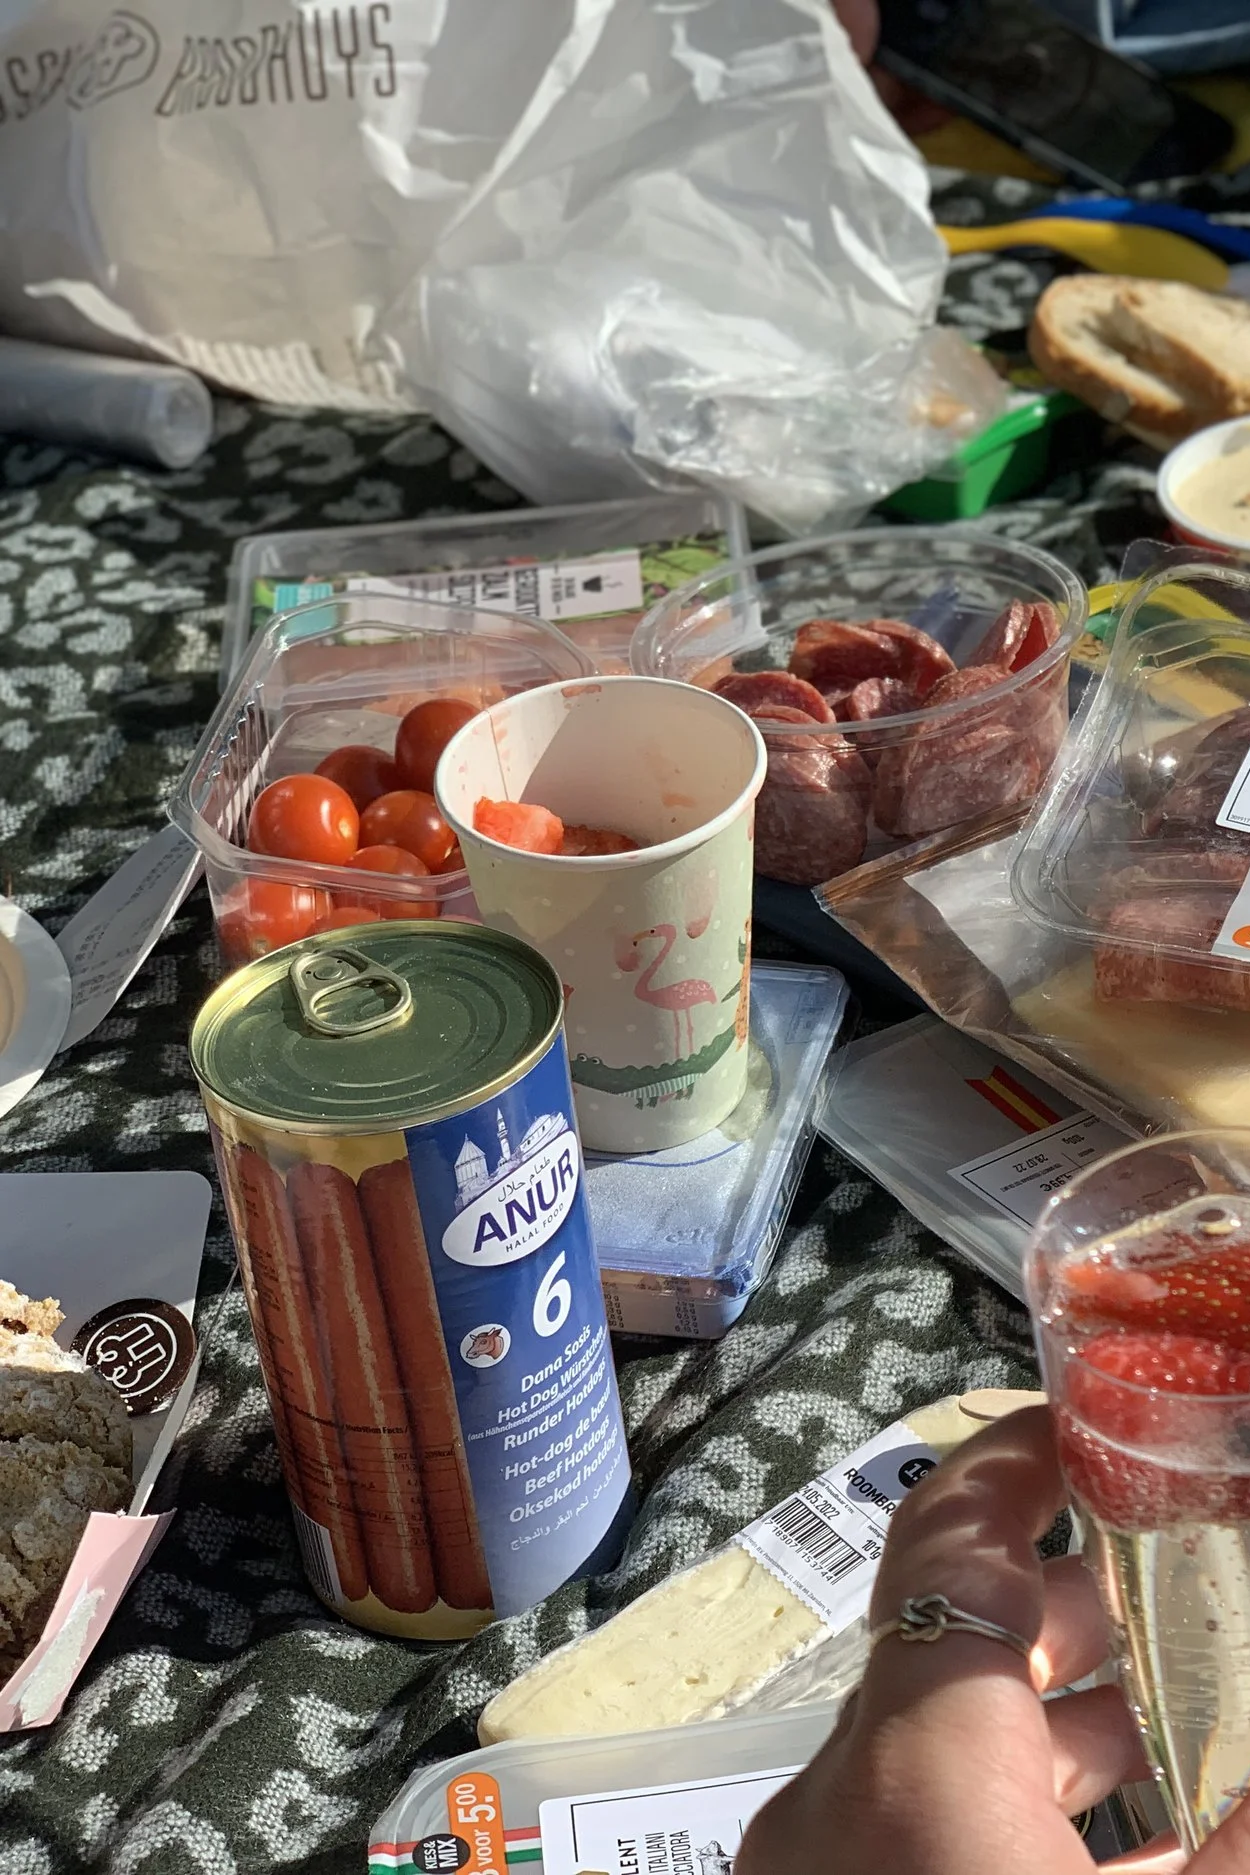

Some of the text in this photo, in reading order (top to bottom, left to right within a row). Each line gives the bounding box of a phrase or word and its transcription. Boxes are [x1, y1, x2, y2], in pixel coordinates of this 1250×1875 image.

[473, 1148, 574, 1253] ANUR
[505, 1202, 564, 1253] HALAL FOOD
[533, 1250, 571, 1337] 6
[521, 1356, 562, 1393] Dana
[564, 1324, 591, 1362] Sosis
[497, 1399, 527, 1424] Hot
[530, 1382, 559, 1410] Dog
[503, 1357, 606, 1452] Runder Hotdogs
[574, 1416, 590, 1440] de
[525, 1461, 562, 1496] Beef
[564, 1415, 610, 1473] Hotdogs
[583, 1425, 618, 1481] hotdogs
[843, 1467, 895, 1517] ROOMBR
[801, 1551, 834, 1582] 153744
[861, 1539, 882, 1560] 101g
[457, 1783, 495, 1823] 5.00
[437, 1837, 459, 1873] MIX
[478, 1829, 493, 1861] voor
